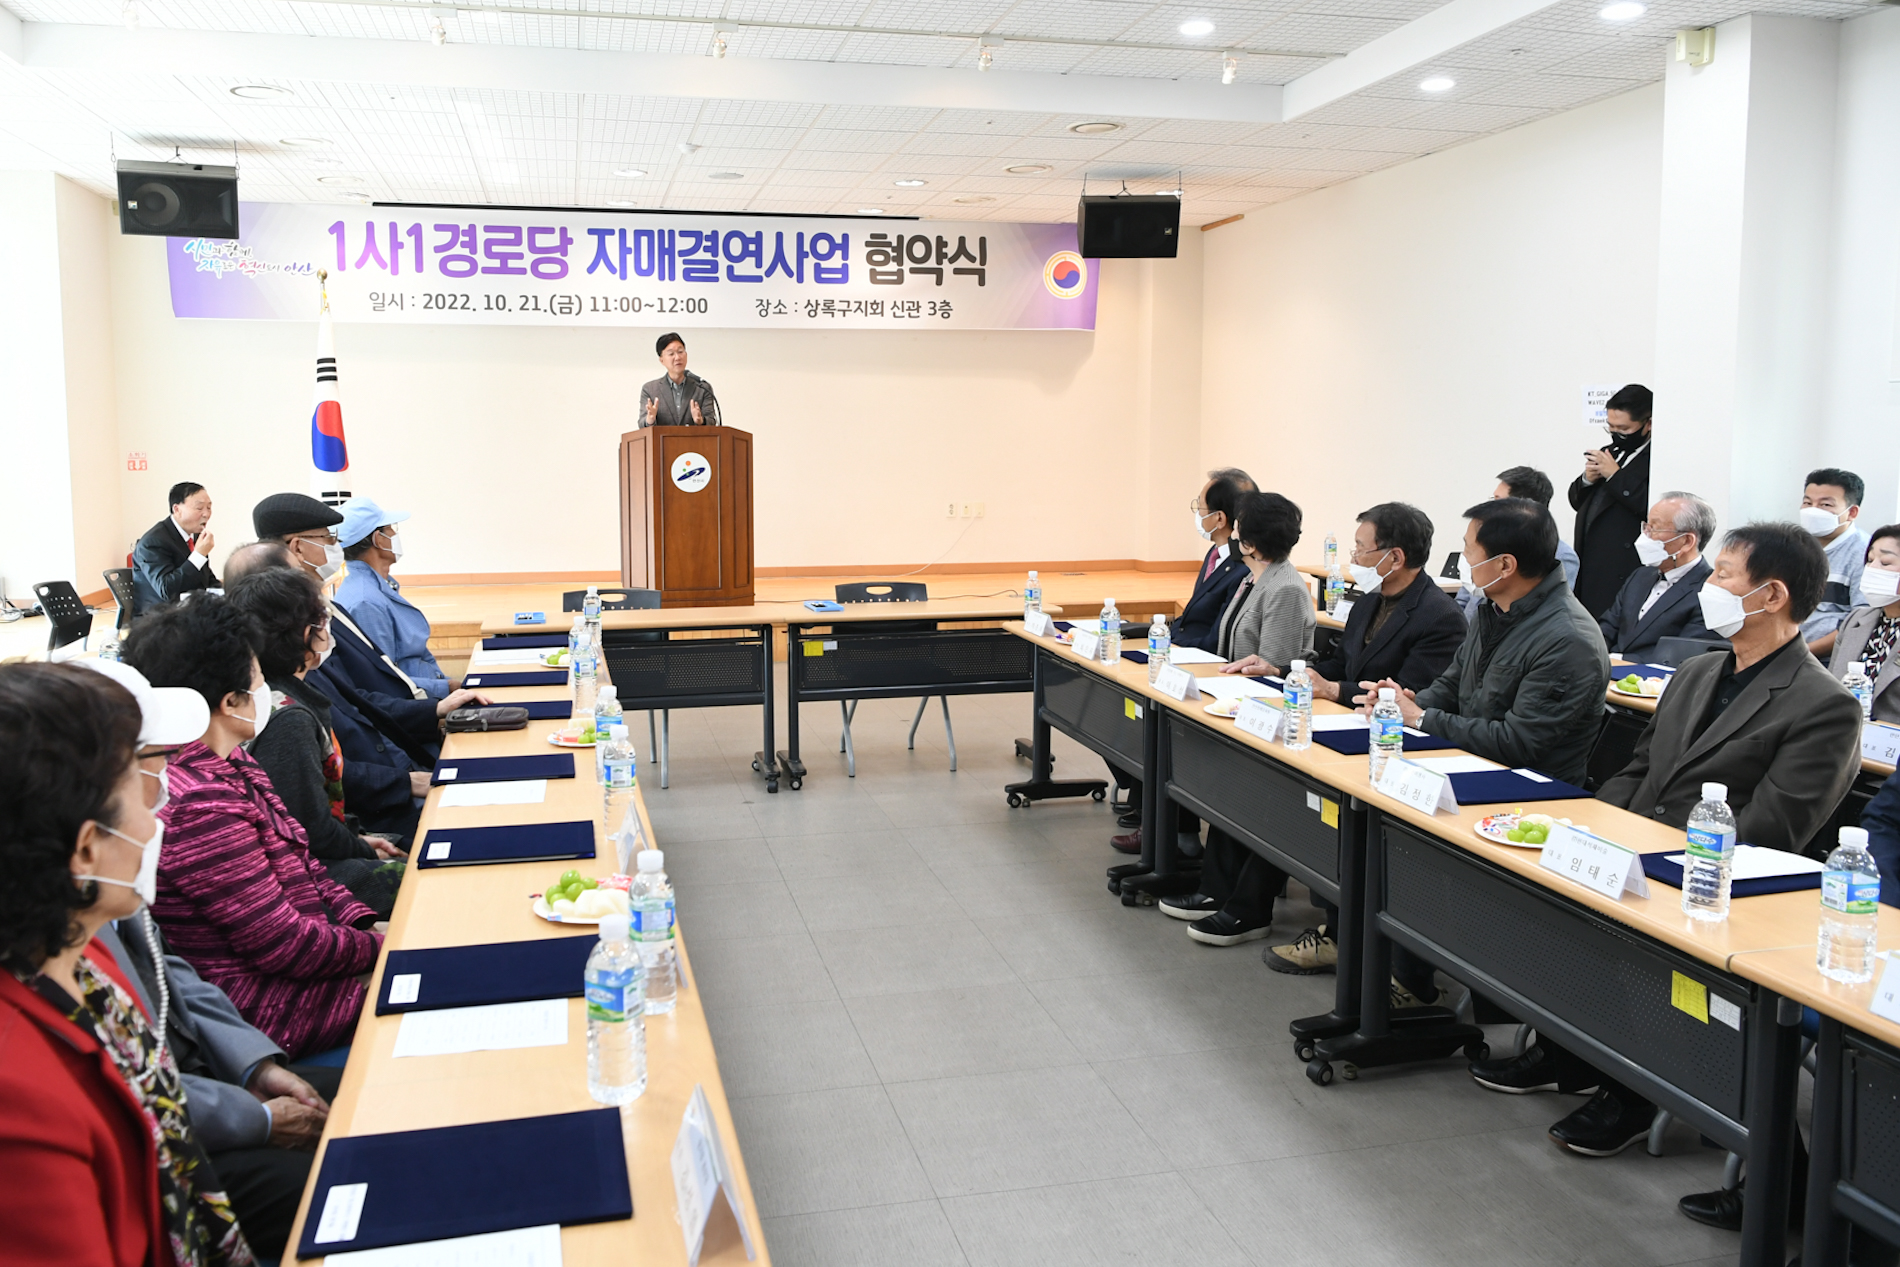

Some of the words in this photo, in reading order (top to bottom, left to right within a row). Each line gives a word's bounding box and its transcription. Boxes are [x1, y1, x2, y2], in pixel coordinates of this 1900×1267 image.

[328, 220, 574, 280] 1사1경로당
[586, 227, 850, 284] 자매결연사업
[864, 232, 988, 287] 협약식
[284, 262, 317, 276] 안산
[368, 291, 405, 312] 일시
[422, 293, 477, 312] 2022.
[483, 293, 512, 313] 10.
[590, 296, 709, 314] 11:00~12:00
[755, 298, 788, 318] 장소
[804, 298, 885, 318] 상록구지회
[890, 300, 922, 319] 신관
[927, 300, 954, 320] 3층
[1570, 857, 1619, 889] 임태순
